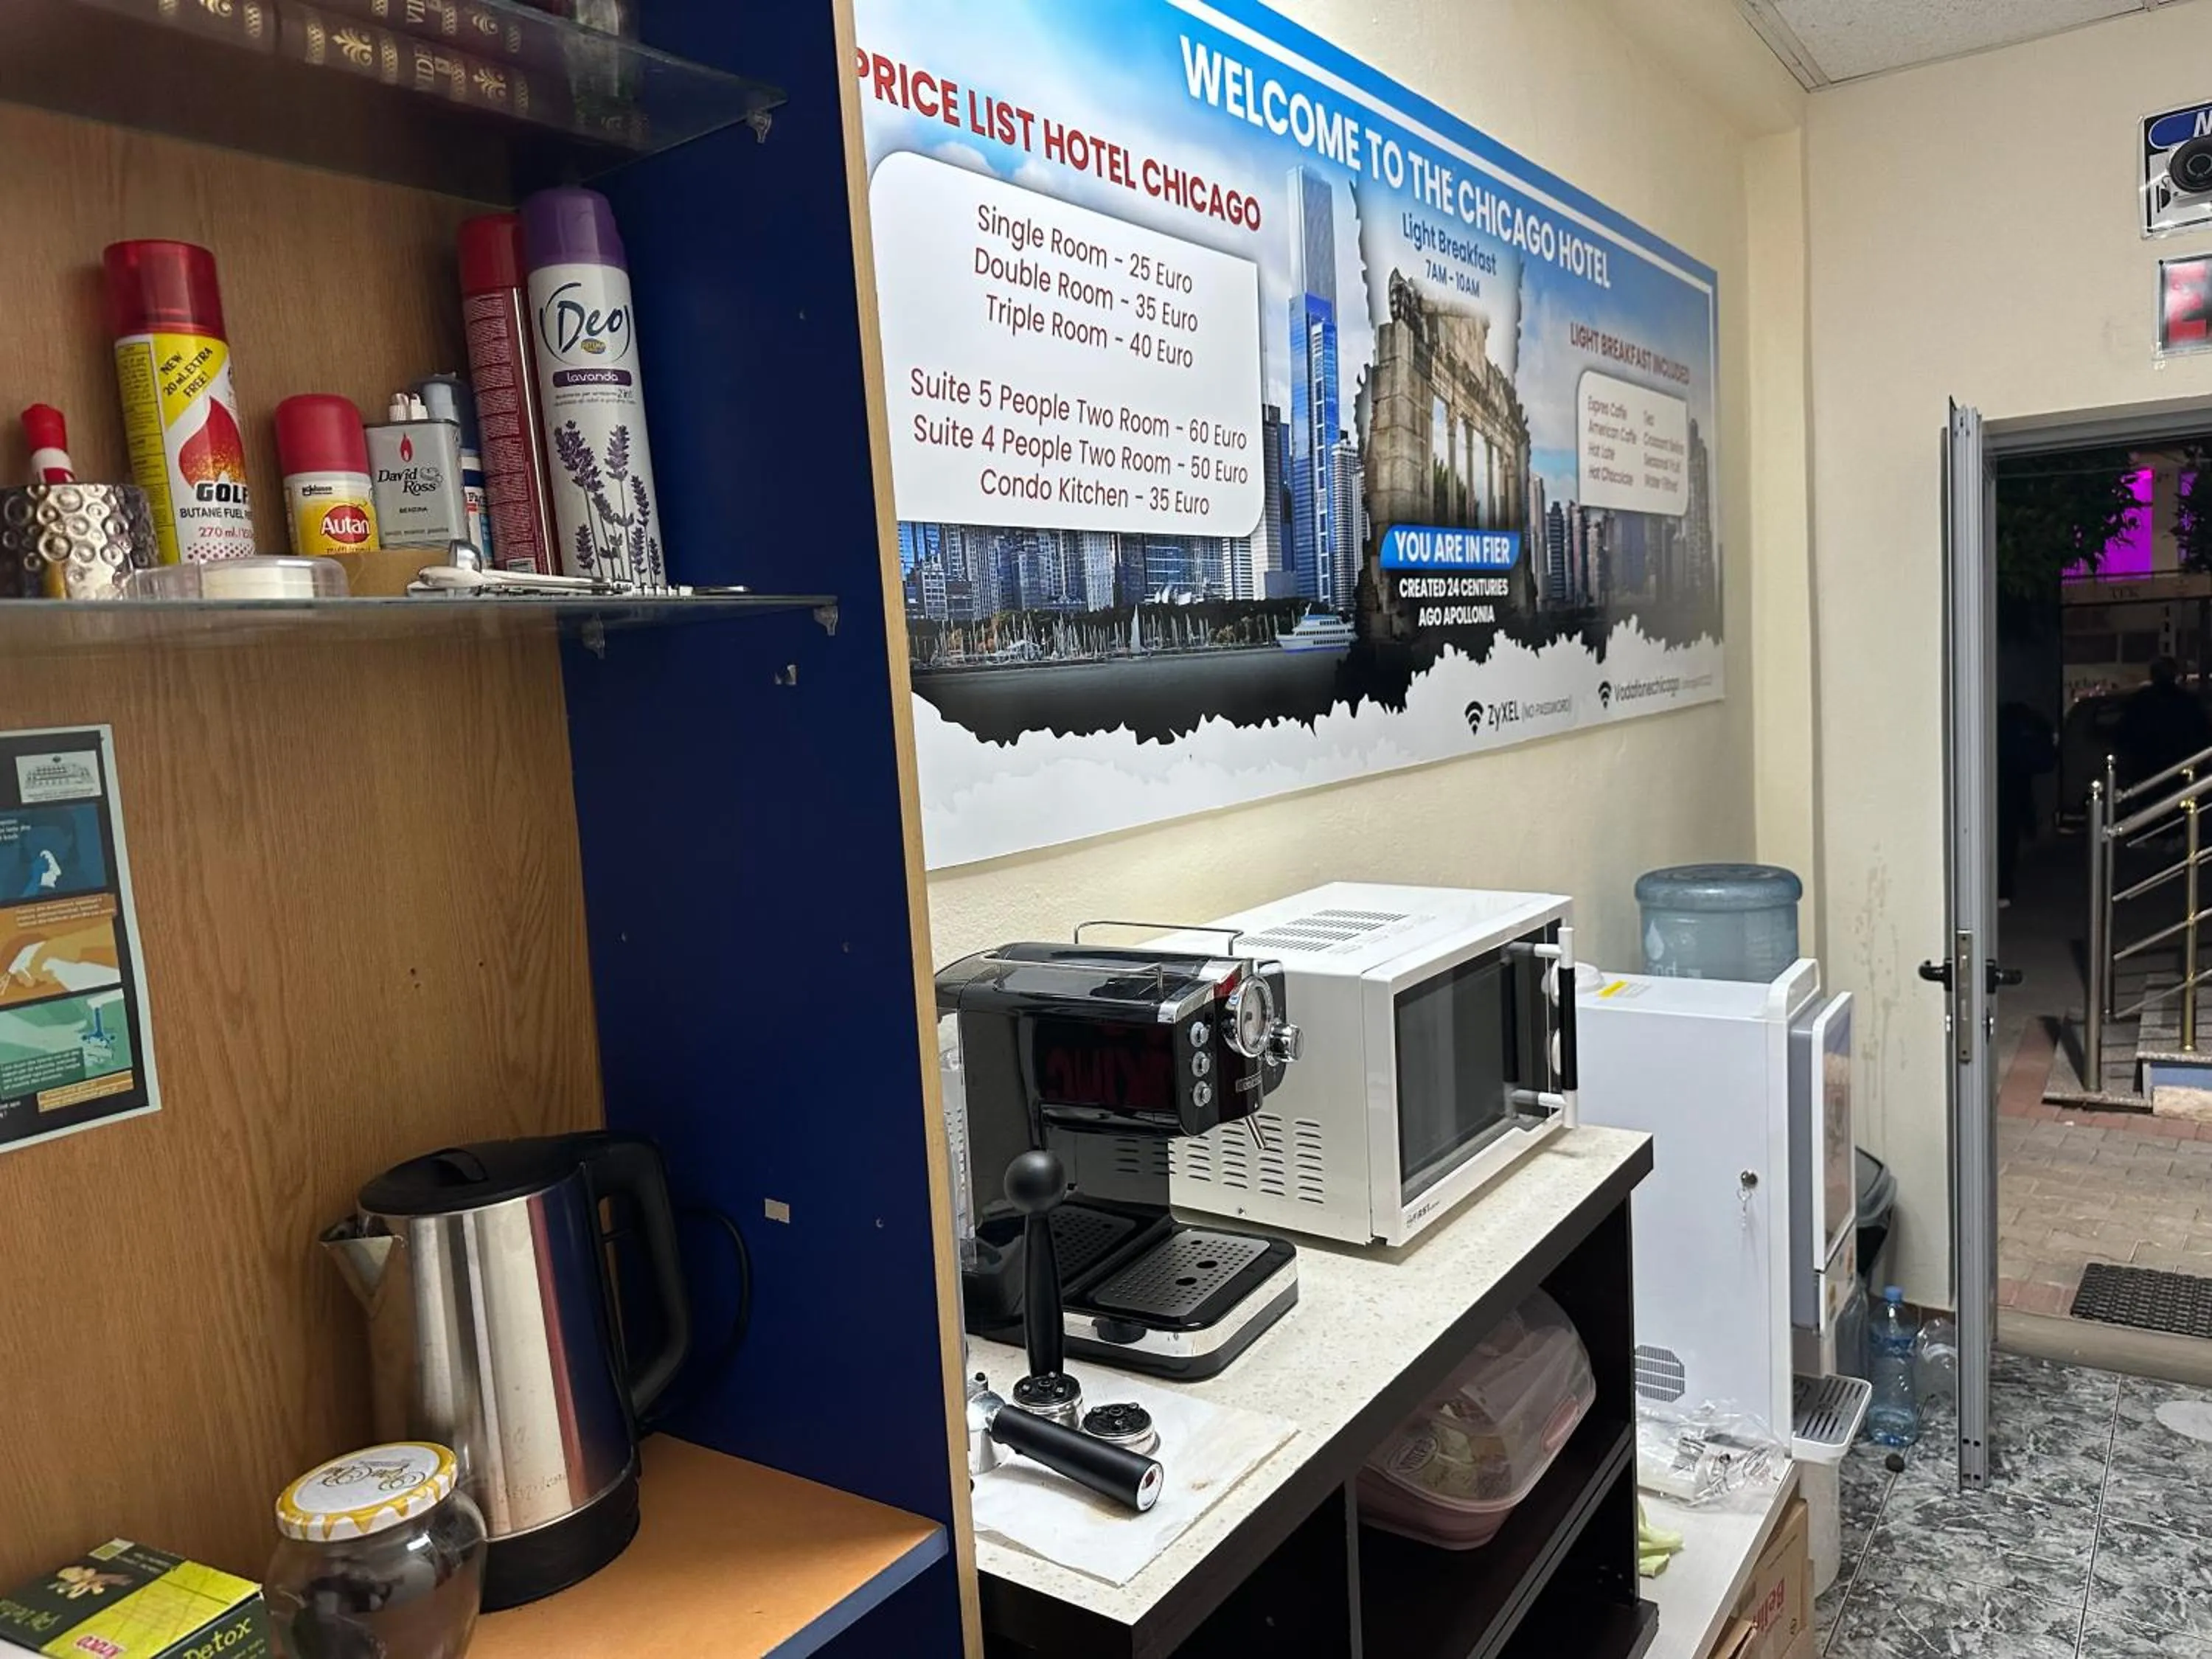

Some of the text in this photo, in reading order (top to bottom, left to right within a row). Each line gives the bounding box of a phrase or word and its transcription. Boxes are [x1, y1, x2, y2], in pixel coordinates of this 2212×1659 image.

[967, 89, 1034, 152] LIST
[1043, 119, 1137, 189] HOTEL
[1142, 158, 1261, 232] CHICAGO
[1180, 35, 1611, 289] WELCOME TO THE CHICAGO HOTEL
[978, 204, 1044, 253] Single
[1051, 229, 1107, 270] Room
[1130, 253, 1150, 282] 25
[1157, 263, 1192, 294] Euro
[1402, 212, 1497, 276] Light Breakfast
[975, 247, 1051, 293] Double
[1058, 274, 1113, 313] Room
[1135, 294, 1155, 322] 35
[1162, 303, 1198, 332] Euro
[1425, 261, 1447, 284] 7AM
[1455, 271, 1480, 298] 10AM
[557, 300, 624, 353] Deo
[987, 295, 1046, 336] Triple
[1052, 313, 1107, 348] Room
[1129, 333, 1152, 358] 40
[1158, 339, 1193, 369] Euro
[160, 354, 183, 375] NEW
[1570, 321, 1599, 354] LIGHT
[1601, 333, 1652, 374] BREAKFAST
[163, 382, 178, 396] 20
[184, 347, 213, 374] EXTRA
[566, 372, 619, 383] lavanda
[911, 368, 971, 404] Suite
[979, 380, 992, 408] 5
[1000, 385, 1070, 426] People
[1077, 400, 1114, 428] Two
[1120, 408, 1169, 439] Room
[1189, 419, 1209, 443] 60
[1214, 424, 1247, 450] Euro
[914, 414, 973, 450] Suite
[981, 425, 995, 451] 4
[1003, 428, 1071, 468] People
[1079, 440, 1116, 468] Two
[1121, 446, 1171, 476] Room
[1191, 457, 1211, 480] 50
[1215, 459, 1248, 484] Euro
[377, 467, 418, 483] David
[403, 480, 437, 496] Ross
[981, 469, 1052, 500] Condo
[1059, 477, 1128, 508] Kitchen
[1150, 487, 1169, 511] 35
[1175, 491, 1210, 515] Euro
[179, 507, 222, 518] BUTANE
[223, 508, 244, 519] FUEL
[199, 526, 223, 538] 270
[321, 516, 370, 535] Autan
[1394, 531, 1510, 564] YOU ARE IN FIER
[1399, 578, 1509, 598] CREATED 24 CENTURIES
[1418, 605, 1495, 627] AGO APOLLONIA
[1487, 700, 1520, 731] ZyXEL
